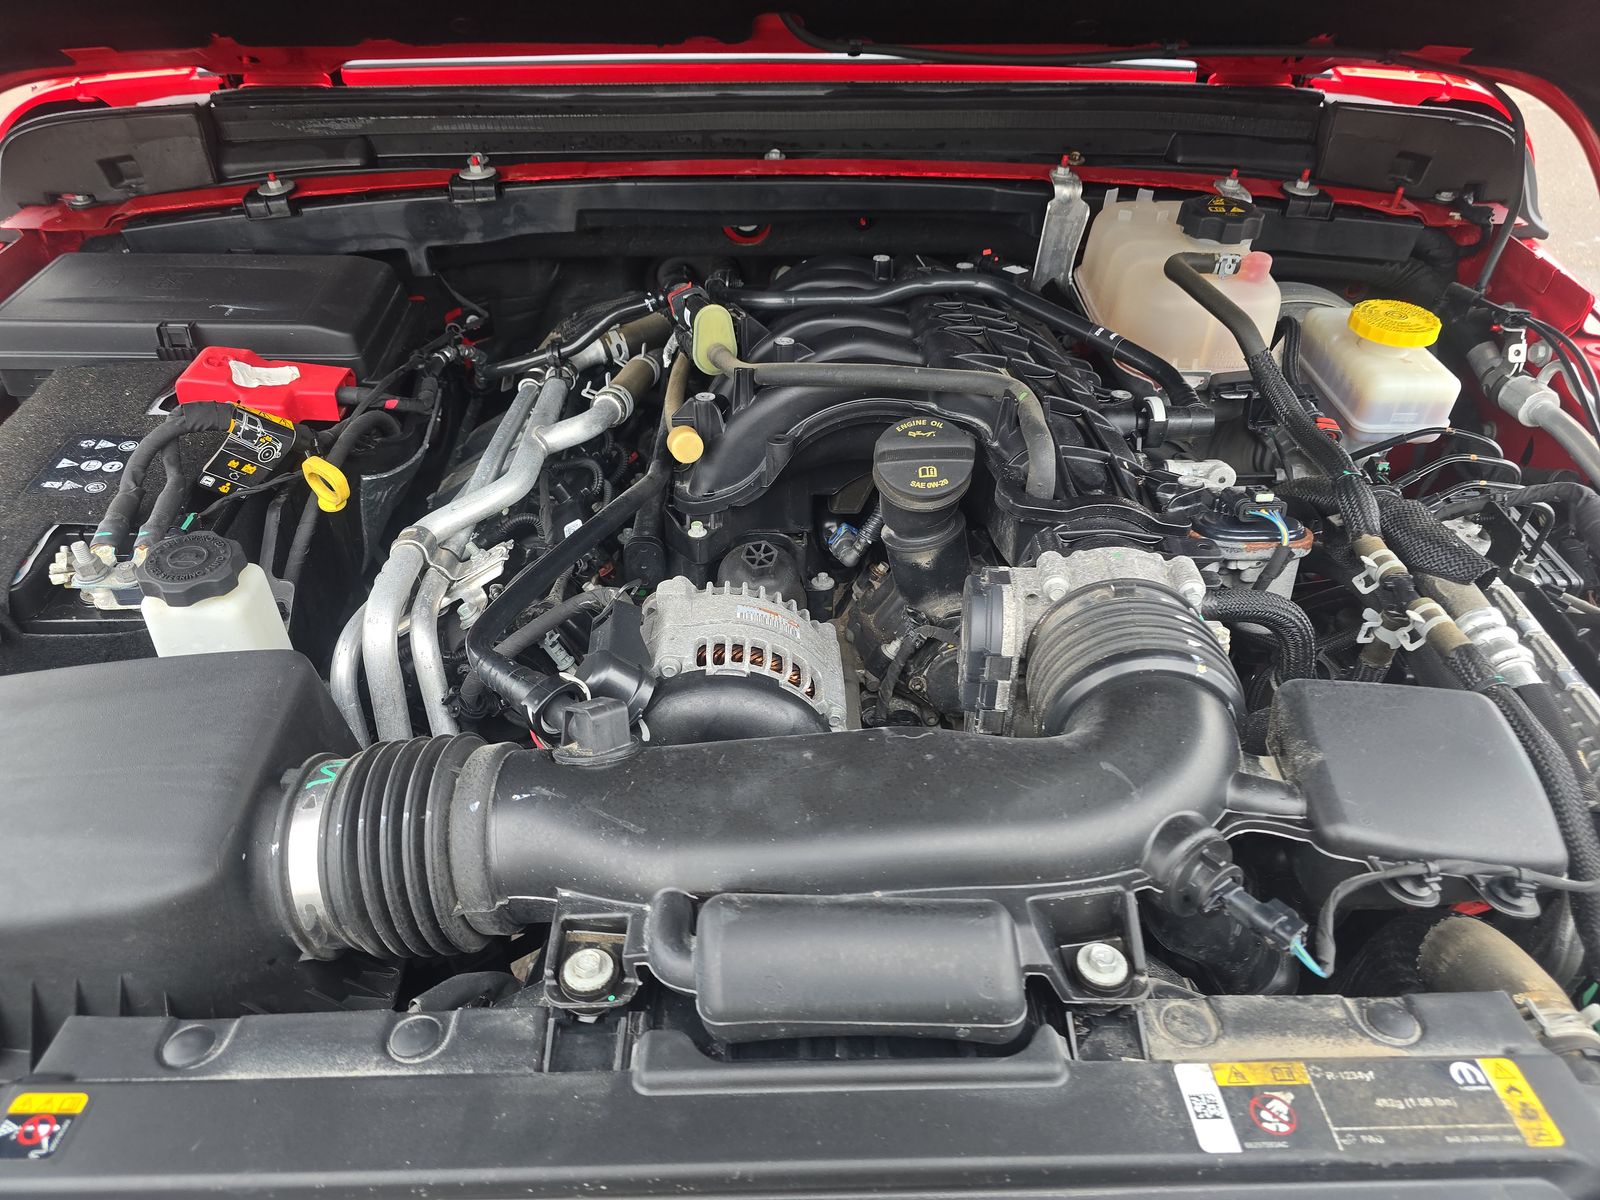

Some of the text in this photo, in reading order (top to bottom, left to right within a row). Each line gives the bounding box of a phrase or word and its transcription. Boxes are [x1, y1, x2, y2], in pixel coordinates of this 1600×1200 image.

[896, 420, 944, 432] ENGINE OIL
[910, 478, 949, 489] SAE 0W-20
[161, 569, 204, 581] STEERING
